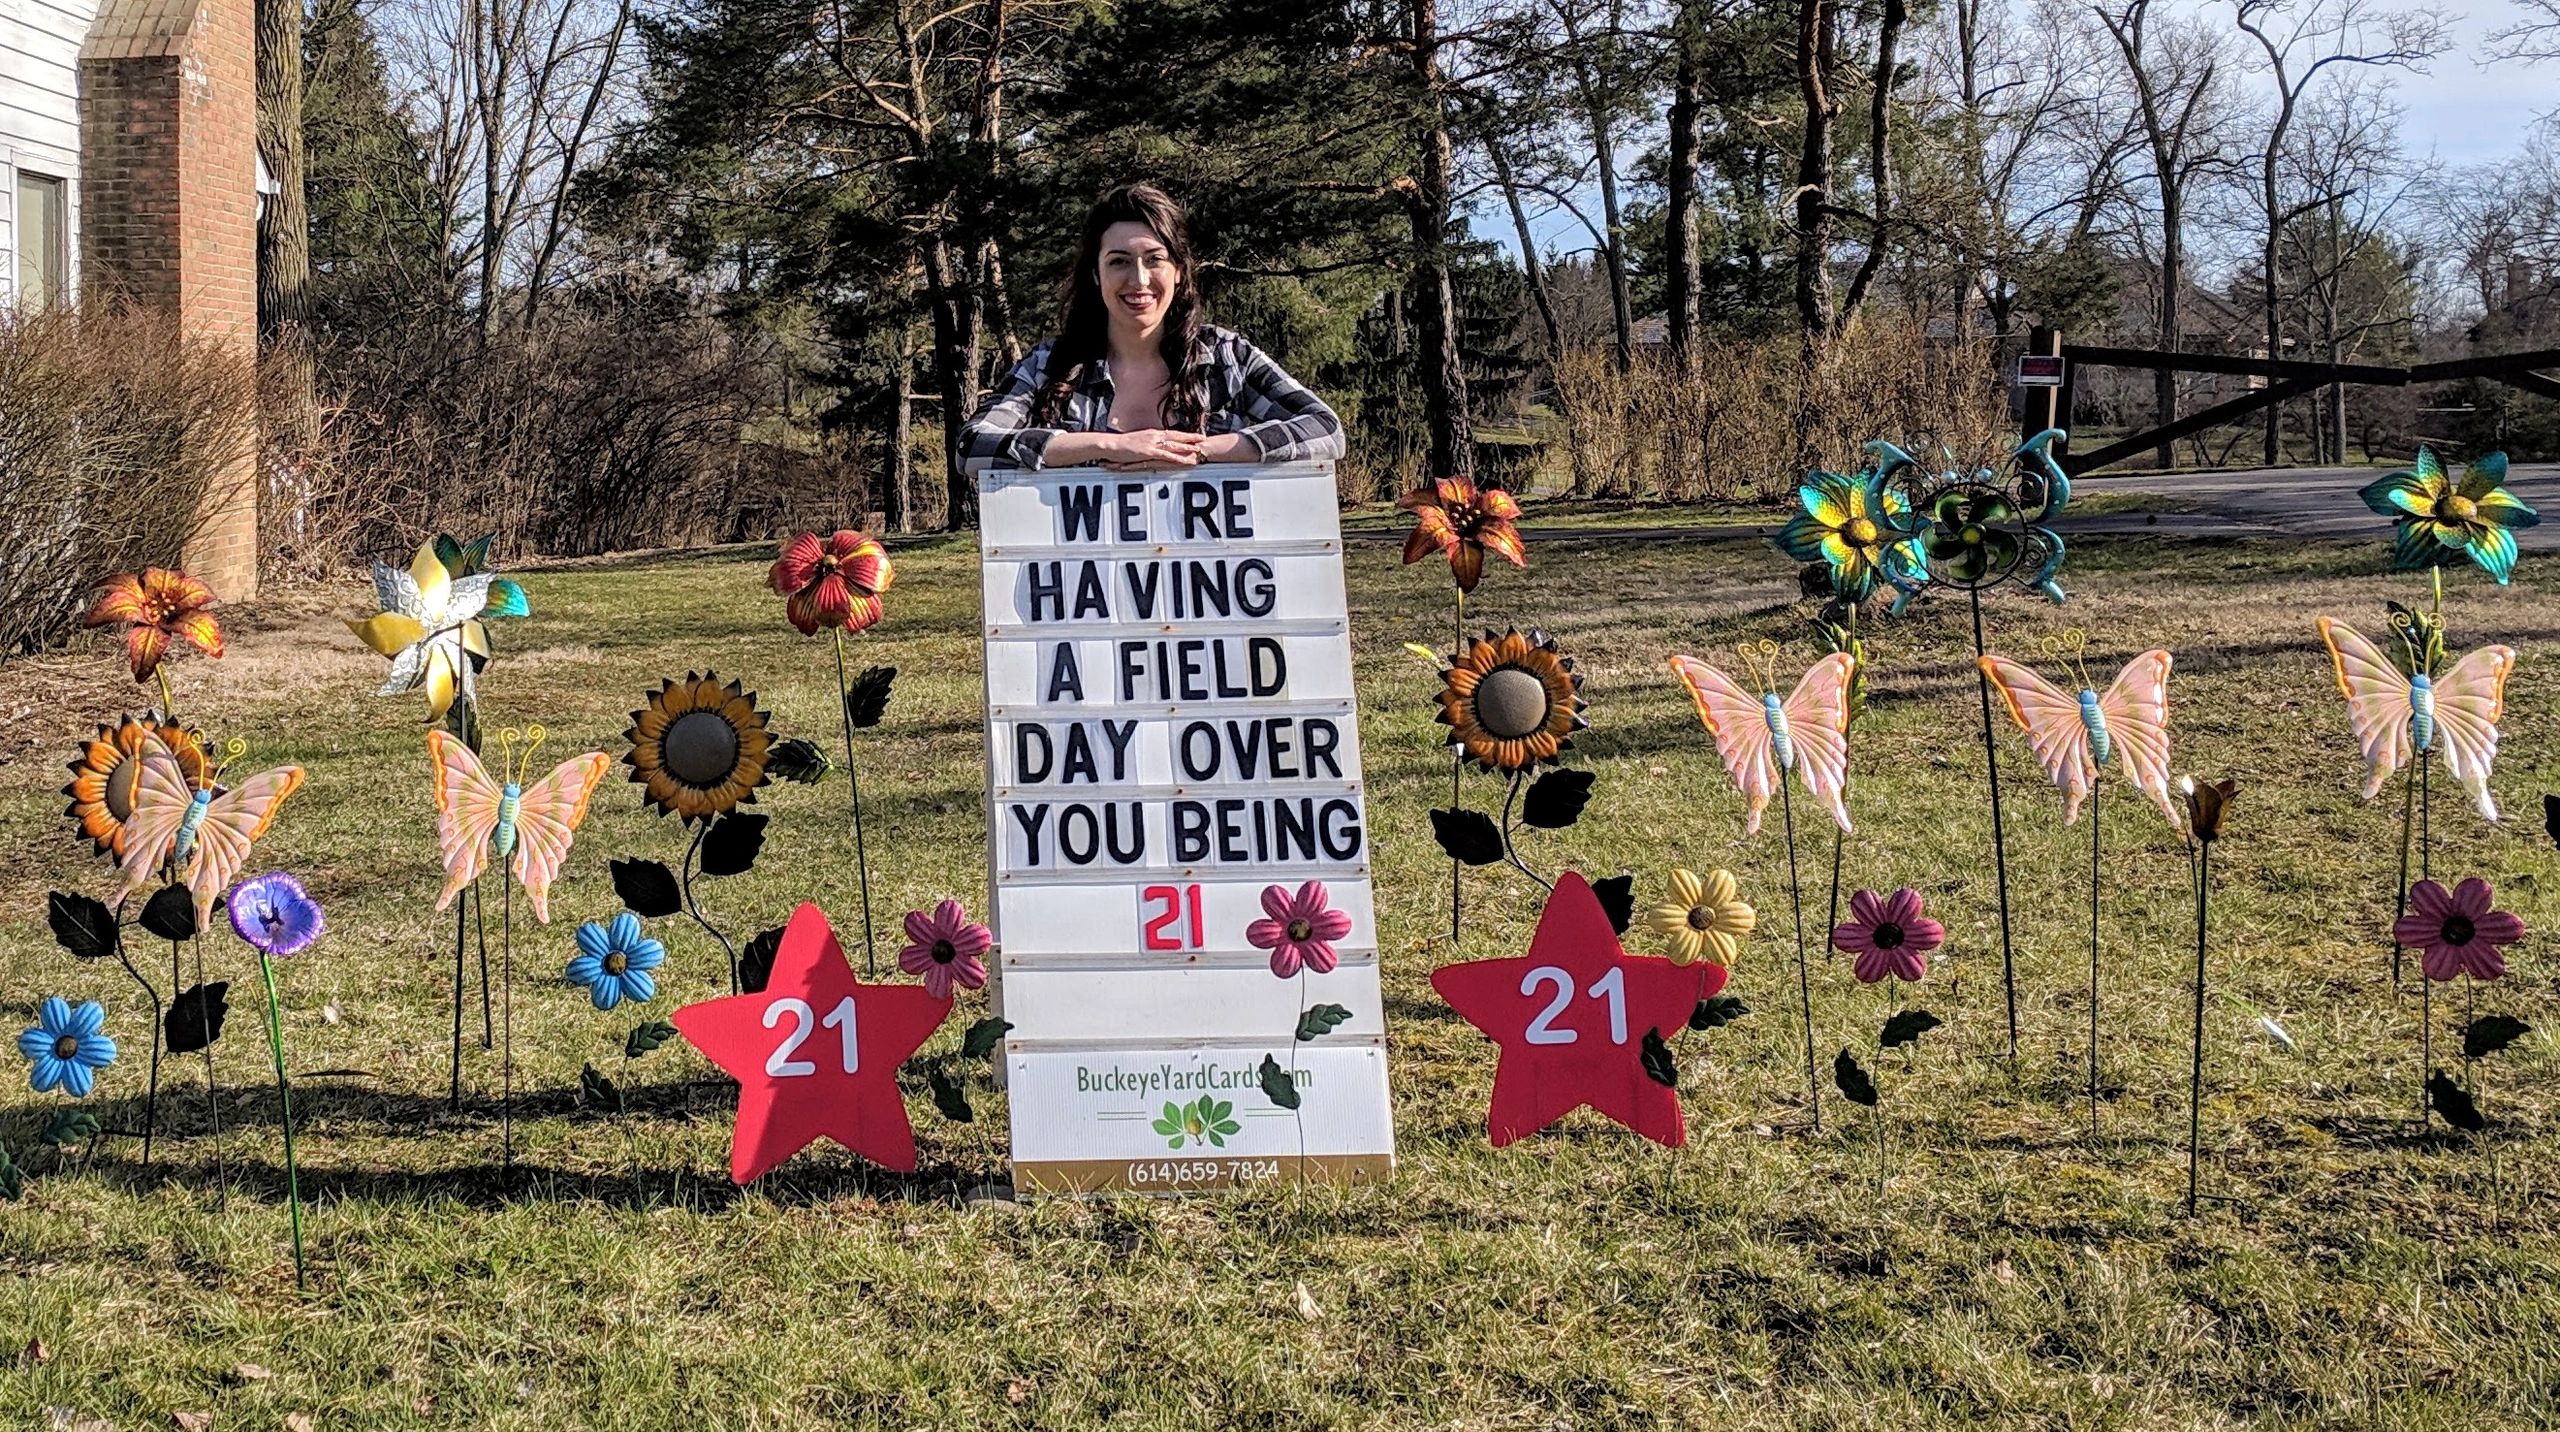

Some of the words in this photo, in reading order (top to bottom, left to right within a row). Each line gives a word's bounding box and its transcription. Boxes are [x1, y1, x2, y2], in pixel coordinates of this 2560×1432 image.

[1059, 480, 1253, 541] WE'RE
[1028, 558, 1276, 622] HAVING
[1048, 642, 1084, 701] A
[1120, 637, 1287, 701] FIELD
[1016, 719, 1139, 784] DAY
[1180, 717, 1343, 780] OVER
[1012, 801, 1145, 866] YOU
[1172, 798, 1362, 862] BEING
[1144, 884, 1204, 950] 21
[762, 996, 859, 1077] 21
[1520, 966, 1628, 1045] 21
[1077, 1063, 1313, 1099] BuckeyeYardCardsm
[1128, 1160, 1280, 1186] (614)659-7824
